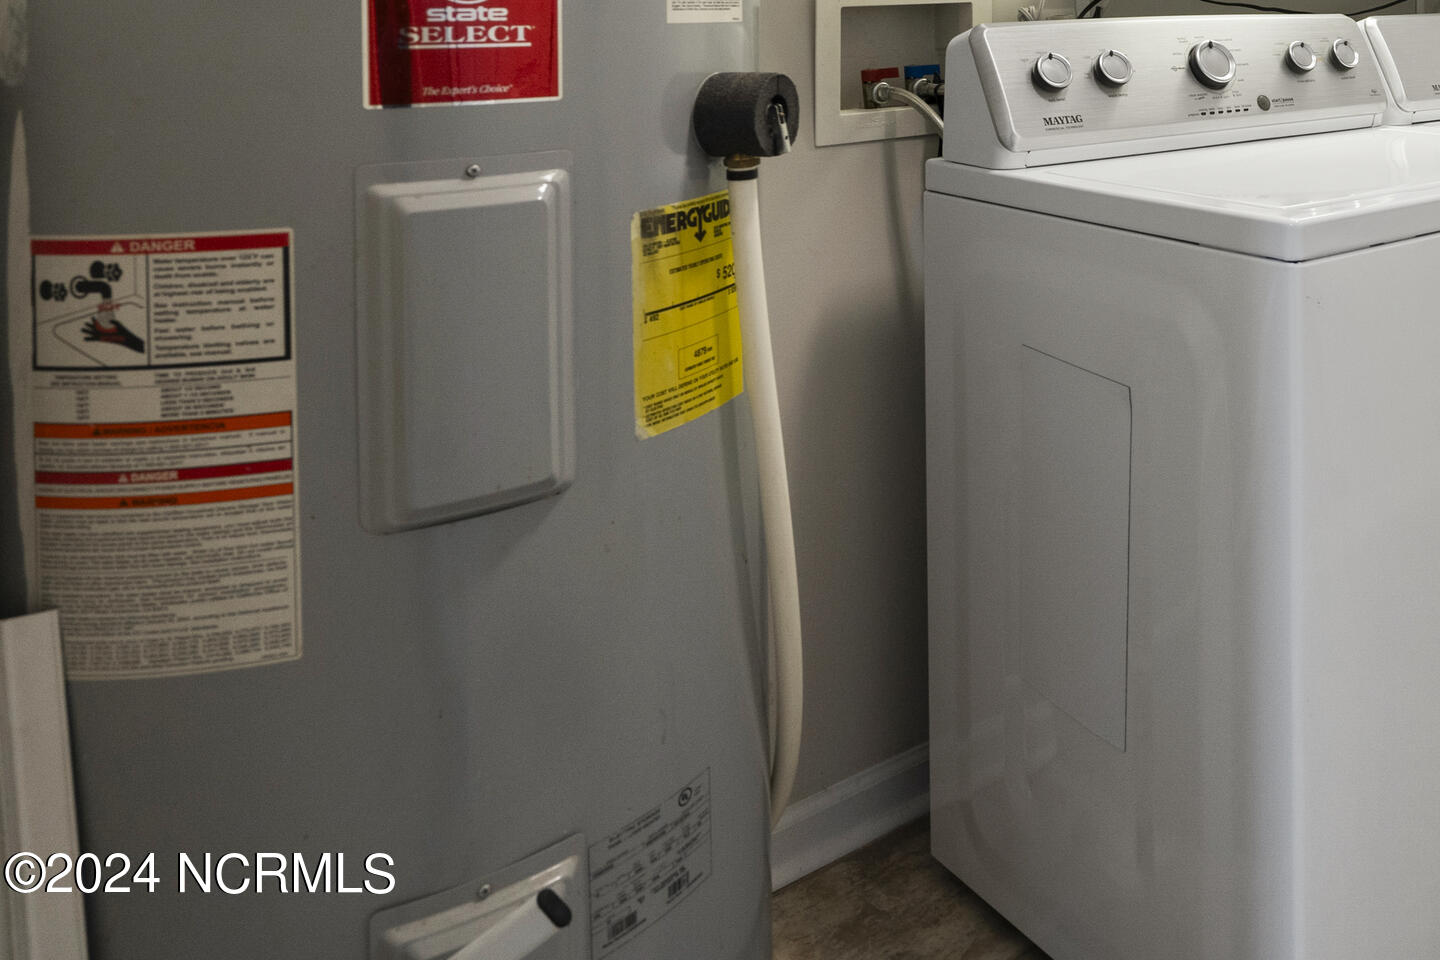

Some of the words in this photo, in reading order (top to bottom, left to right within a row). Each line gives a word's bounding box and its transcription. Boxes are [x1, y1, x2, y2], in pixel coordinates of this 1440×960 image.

[426, 5, 509, 22] state
[400, 24, 533, 44] SELECT
[423, 87, 439, 96] The
[441, 85, 478, 97] Expert's
[479, 84, 510, 95] Choice
[1042, 114, 1084, 126] MAYTAG
[641, 199, 730, 239] ENERGYGUID
[129, 239, 196, 252] DANGER
[130, 470, 179, 482] DANGER
